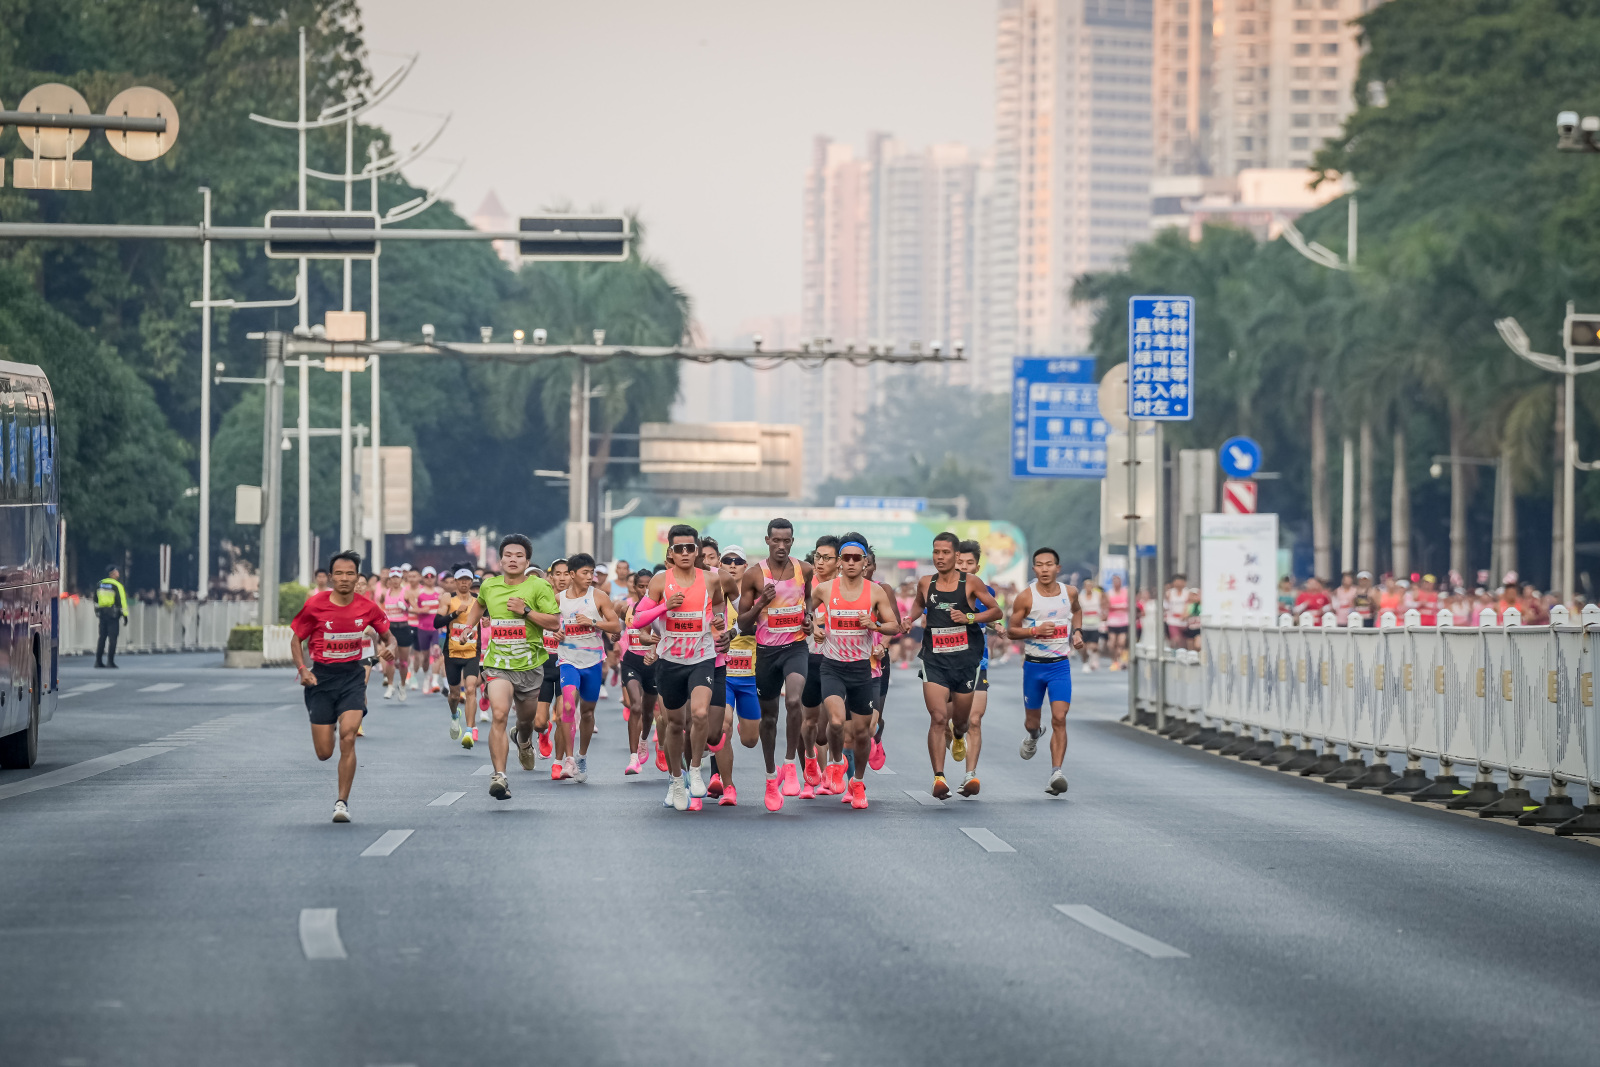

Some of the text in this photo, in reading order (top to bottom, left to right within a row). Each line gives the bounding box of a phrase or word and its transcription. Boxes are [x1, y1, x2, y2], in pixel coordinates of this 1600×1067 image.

[1134, 317, 1152, 415] 直行绿灯亮时
[1152, 301, 1170, 415] 左转车可进入左
[775, 616, 799, 626] ZEBENE
[934, 635, 965, 645] A10015
